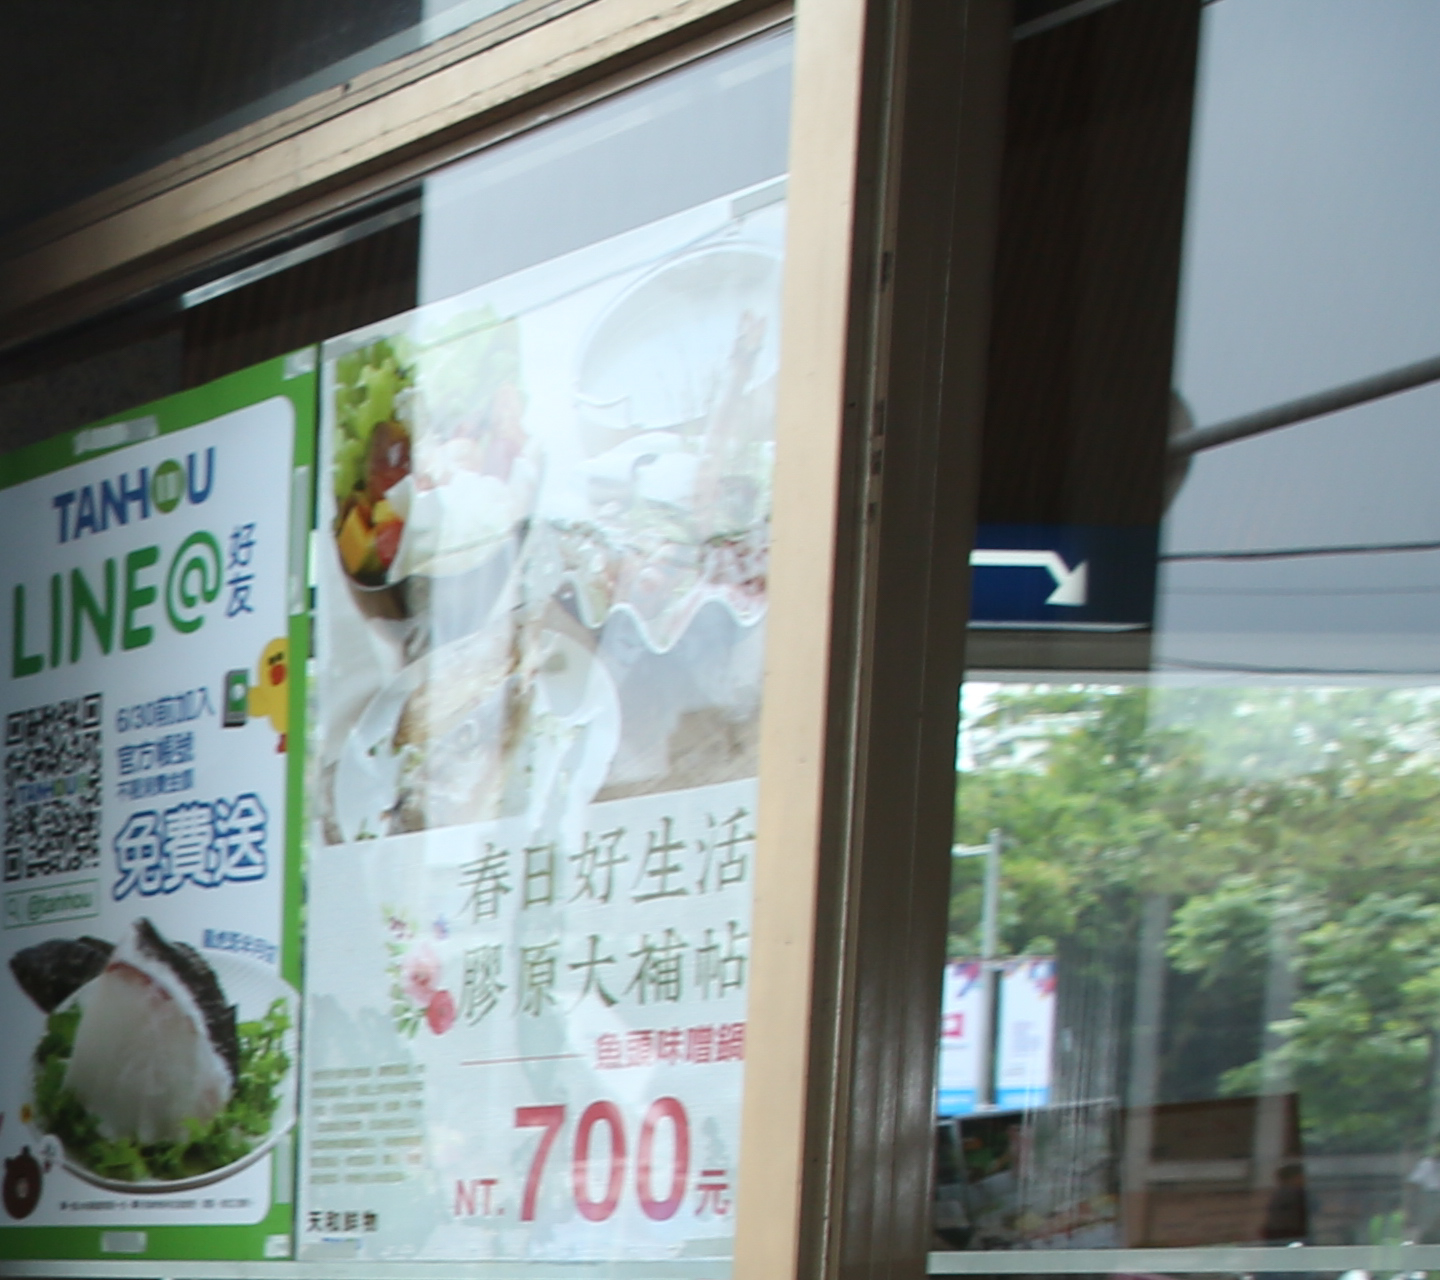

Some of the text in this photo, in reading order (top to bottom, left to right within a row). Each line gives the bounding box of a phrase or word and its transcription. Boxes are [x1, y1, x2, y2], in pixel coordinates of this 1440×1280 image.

[52, 445, 216, 544] TANHOU
[12, 529, 223, 679] LINE@
[226, 522, 257, 618] 好友
[112, 792, 269, 903] 免費送
[456, 806, 757, 925] 春日好生活
[456, 919, 750, 1027] 膠原大補帖
